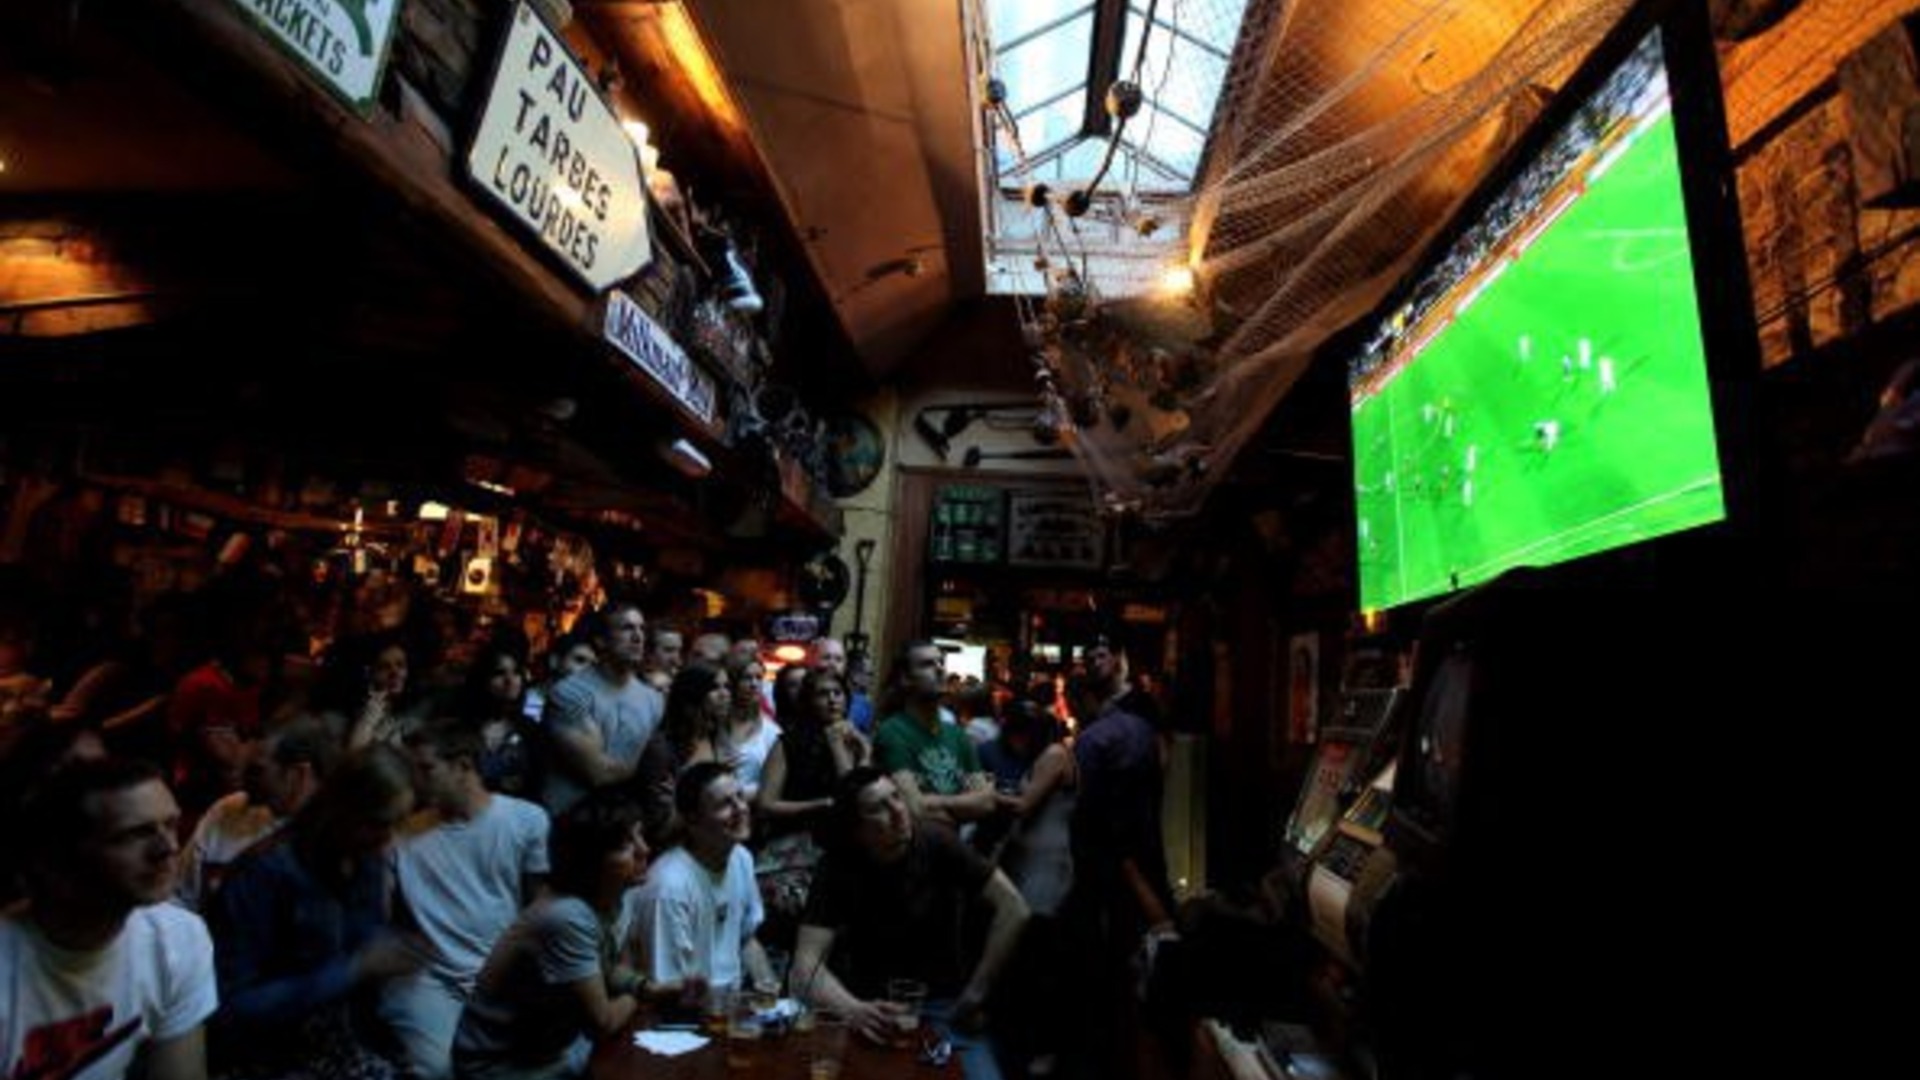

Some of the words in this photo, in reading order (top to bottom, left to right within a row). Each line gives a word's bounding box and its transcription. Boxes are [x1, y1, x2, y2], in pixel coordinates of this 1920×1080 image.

[529, 35, 587, 123] PAU
[493, 146, 599, 269] LOURDES
[515, 88, 612, 222] TARBES
